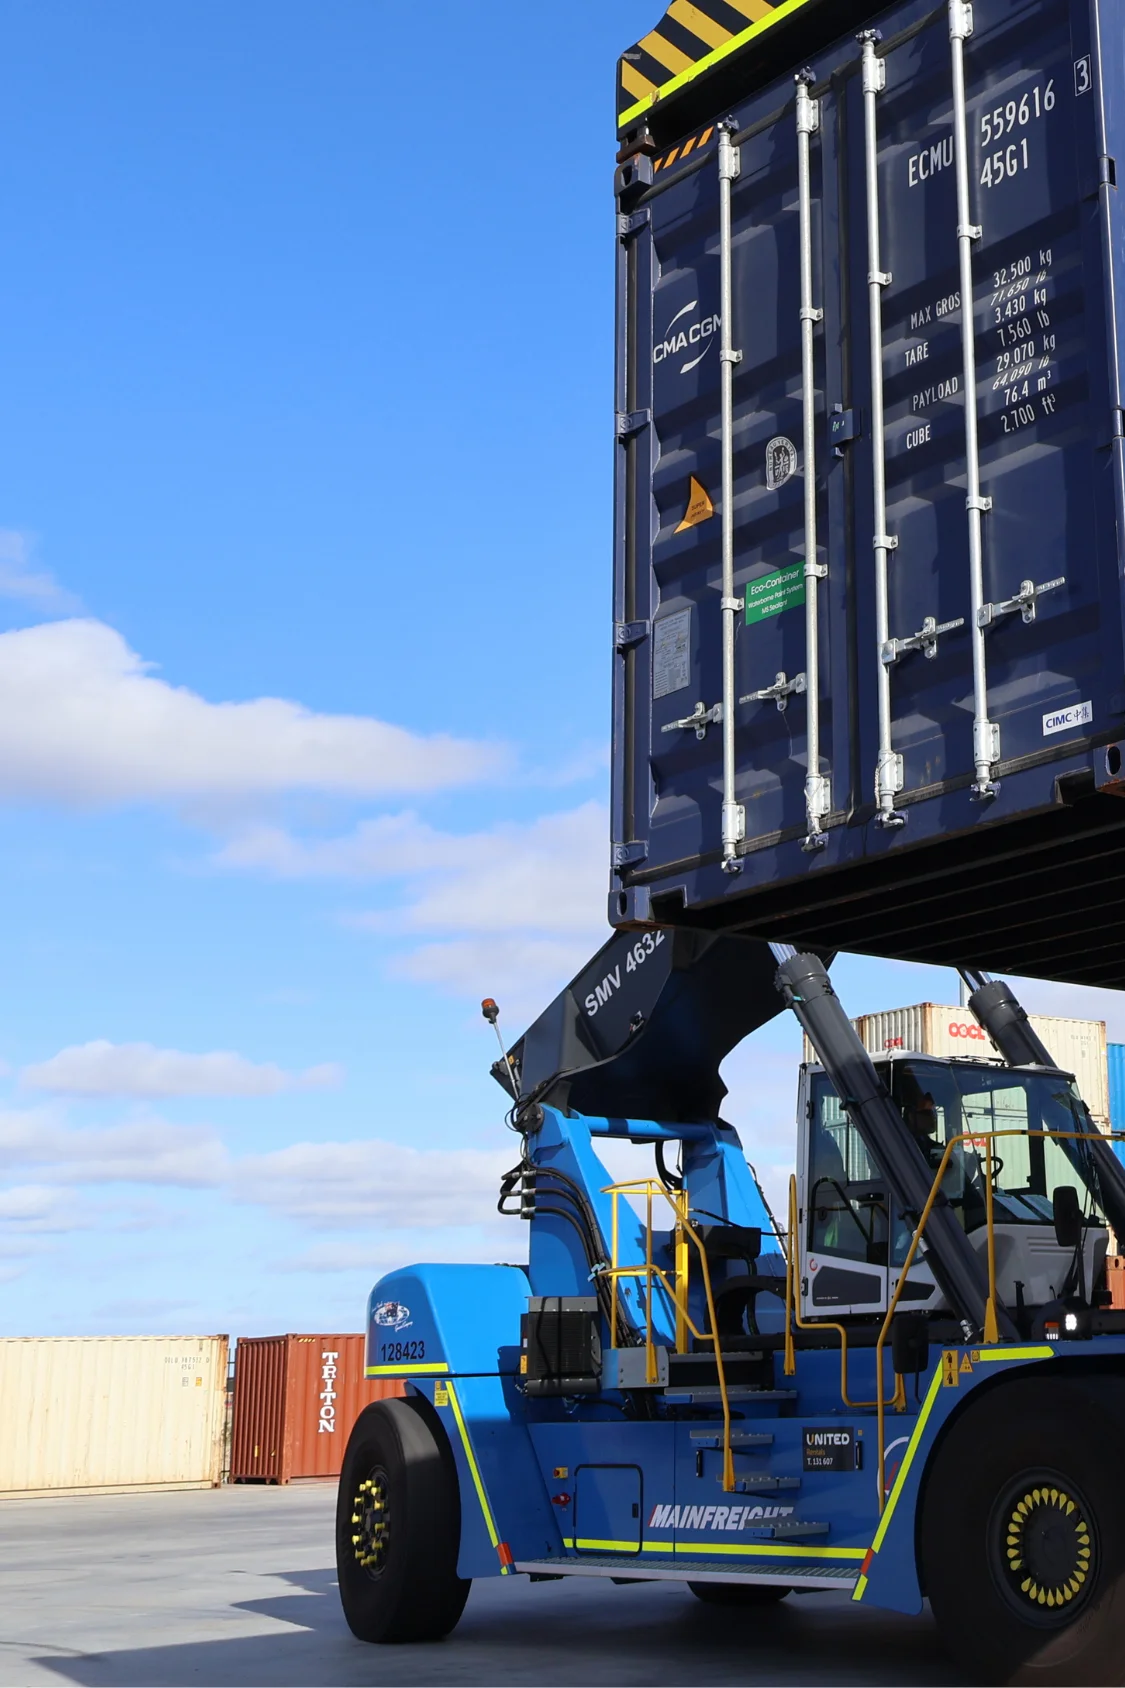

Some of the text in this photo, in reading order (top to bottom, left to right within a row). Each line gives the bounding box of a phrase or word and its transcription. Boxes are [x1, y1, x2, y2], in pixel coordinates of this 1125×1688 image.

[908, 59, 1089, 187] ECMU 559616 3
[980, 138, 1028, 188] 45G1
[993, 249, 1052, 288] 32.500 kg
[990, 277, 1030, 306] 71.650
[994, 288, 1047, 324] 3.430 kg
[910, 291, 961, 330] MAX GROS
[996, 309, 1050, 347] 7.560 lb
[905, 342, 929, 367] TARE
[996, 334, 1056, 373] 29.070 kg
[992, 362, 1033, 390] 64.090
[912, 376, 959, 412] PAYLOAD
[1004, 380, 1029, 407] 76.4
[1000, 404, 1035, 433] 2.700
[906, 424, 931, 450] CUBE
[750, 569, 800, 595] Eco-Container
[1045, 712, 1072, 728] CIMC
[584, 929, 666, 1017] SMV 4632
[948, 1022, 985, 1040] OOCL
[381, 1340, 425, 1362] 128423
[318, 1351, 339, 1433] TRITON
[806, 1433, 850, 1445] UNITED
[812, 1457, 822, 1466] 131
[822, 1457, 833, 1466] 607
